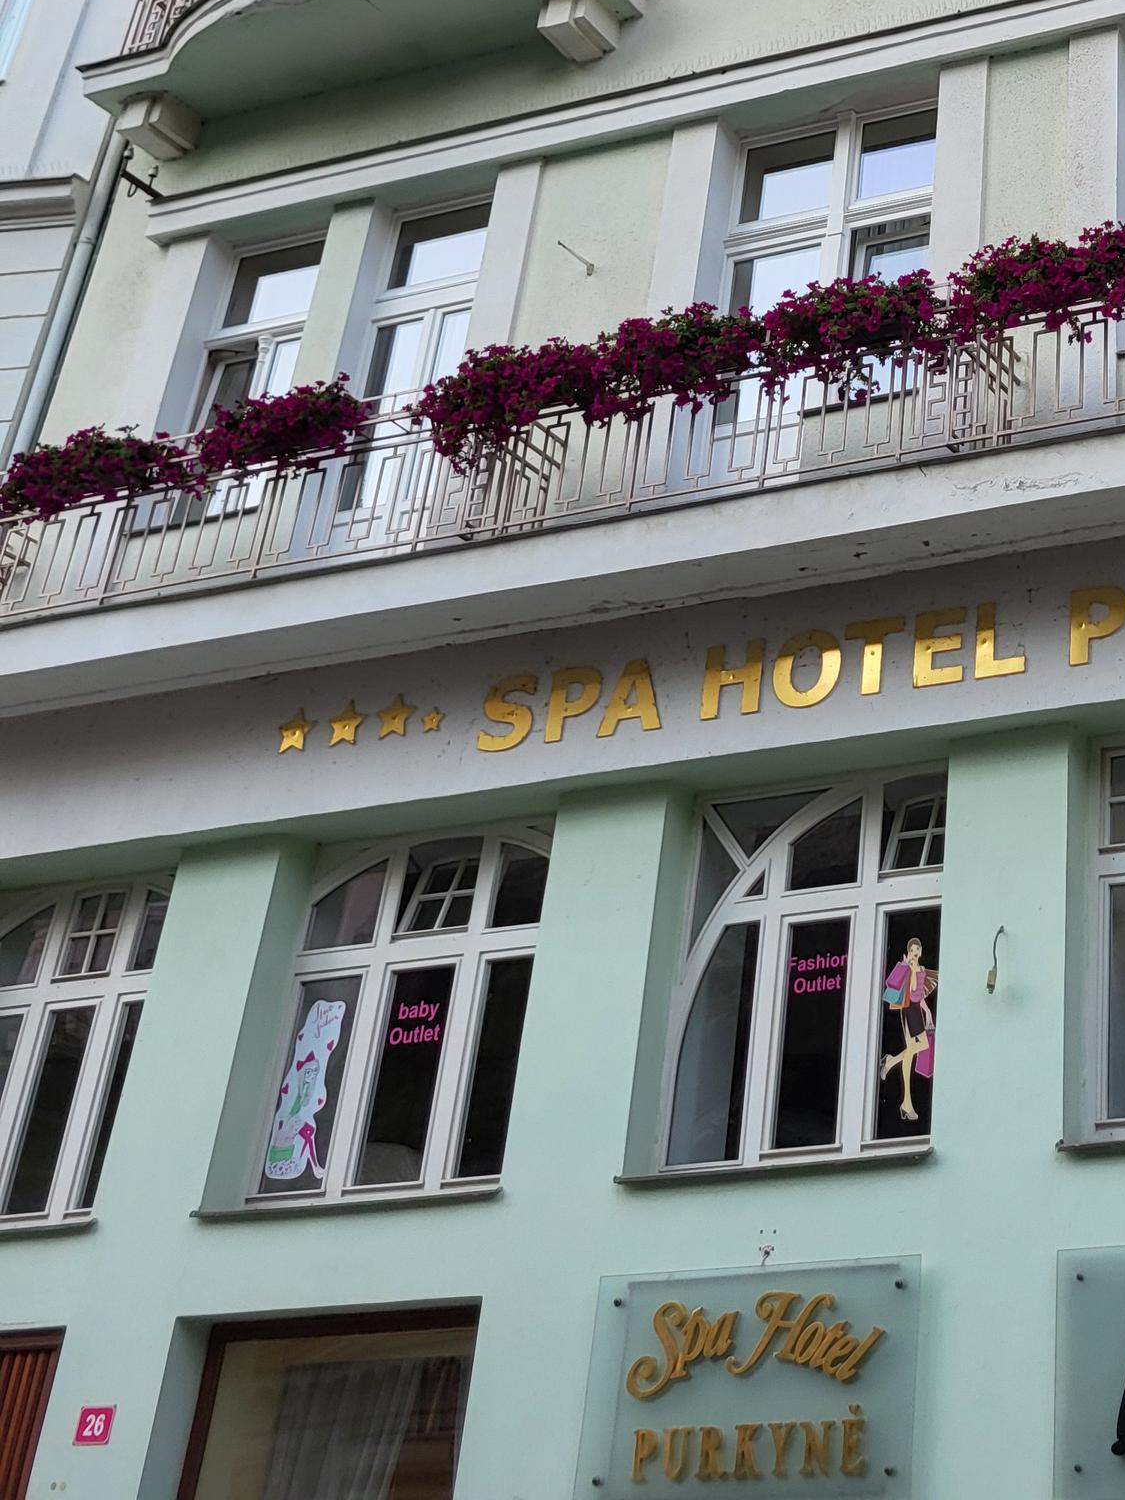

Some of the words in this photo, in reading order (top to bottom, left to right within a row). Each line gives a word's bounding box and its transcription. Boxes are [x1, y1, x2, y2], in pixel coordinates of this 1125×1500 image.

[475, 656, 664, 753] SPA
[699, 600, 1027, 722] HOTEL
[793, 973, 842, 994] Outlet
[398, 1000, 440, 1022] baby
[389, 1023, 441, 1046] Outlet
[626, 1300, 742, 1401] Spa
[724, 1289, 887, 1383] Hotel
[82, 1412, 107, 1438] 26
[630, 1402, 867, 1484] PURKYNĚ
